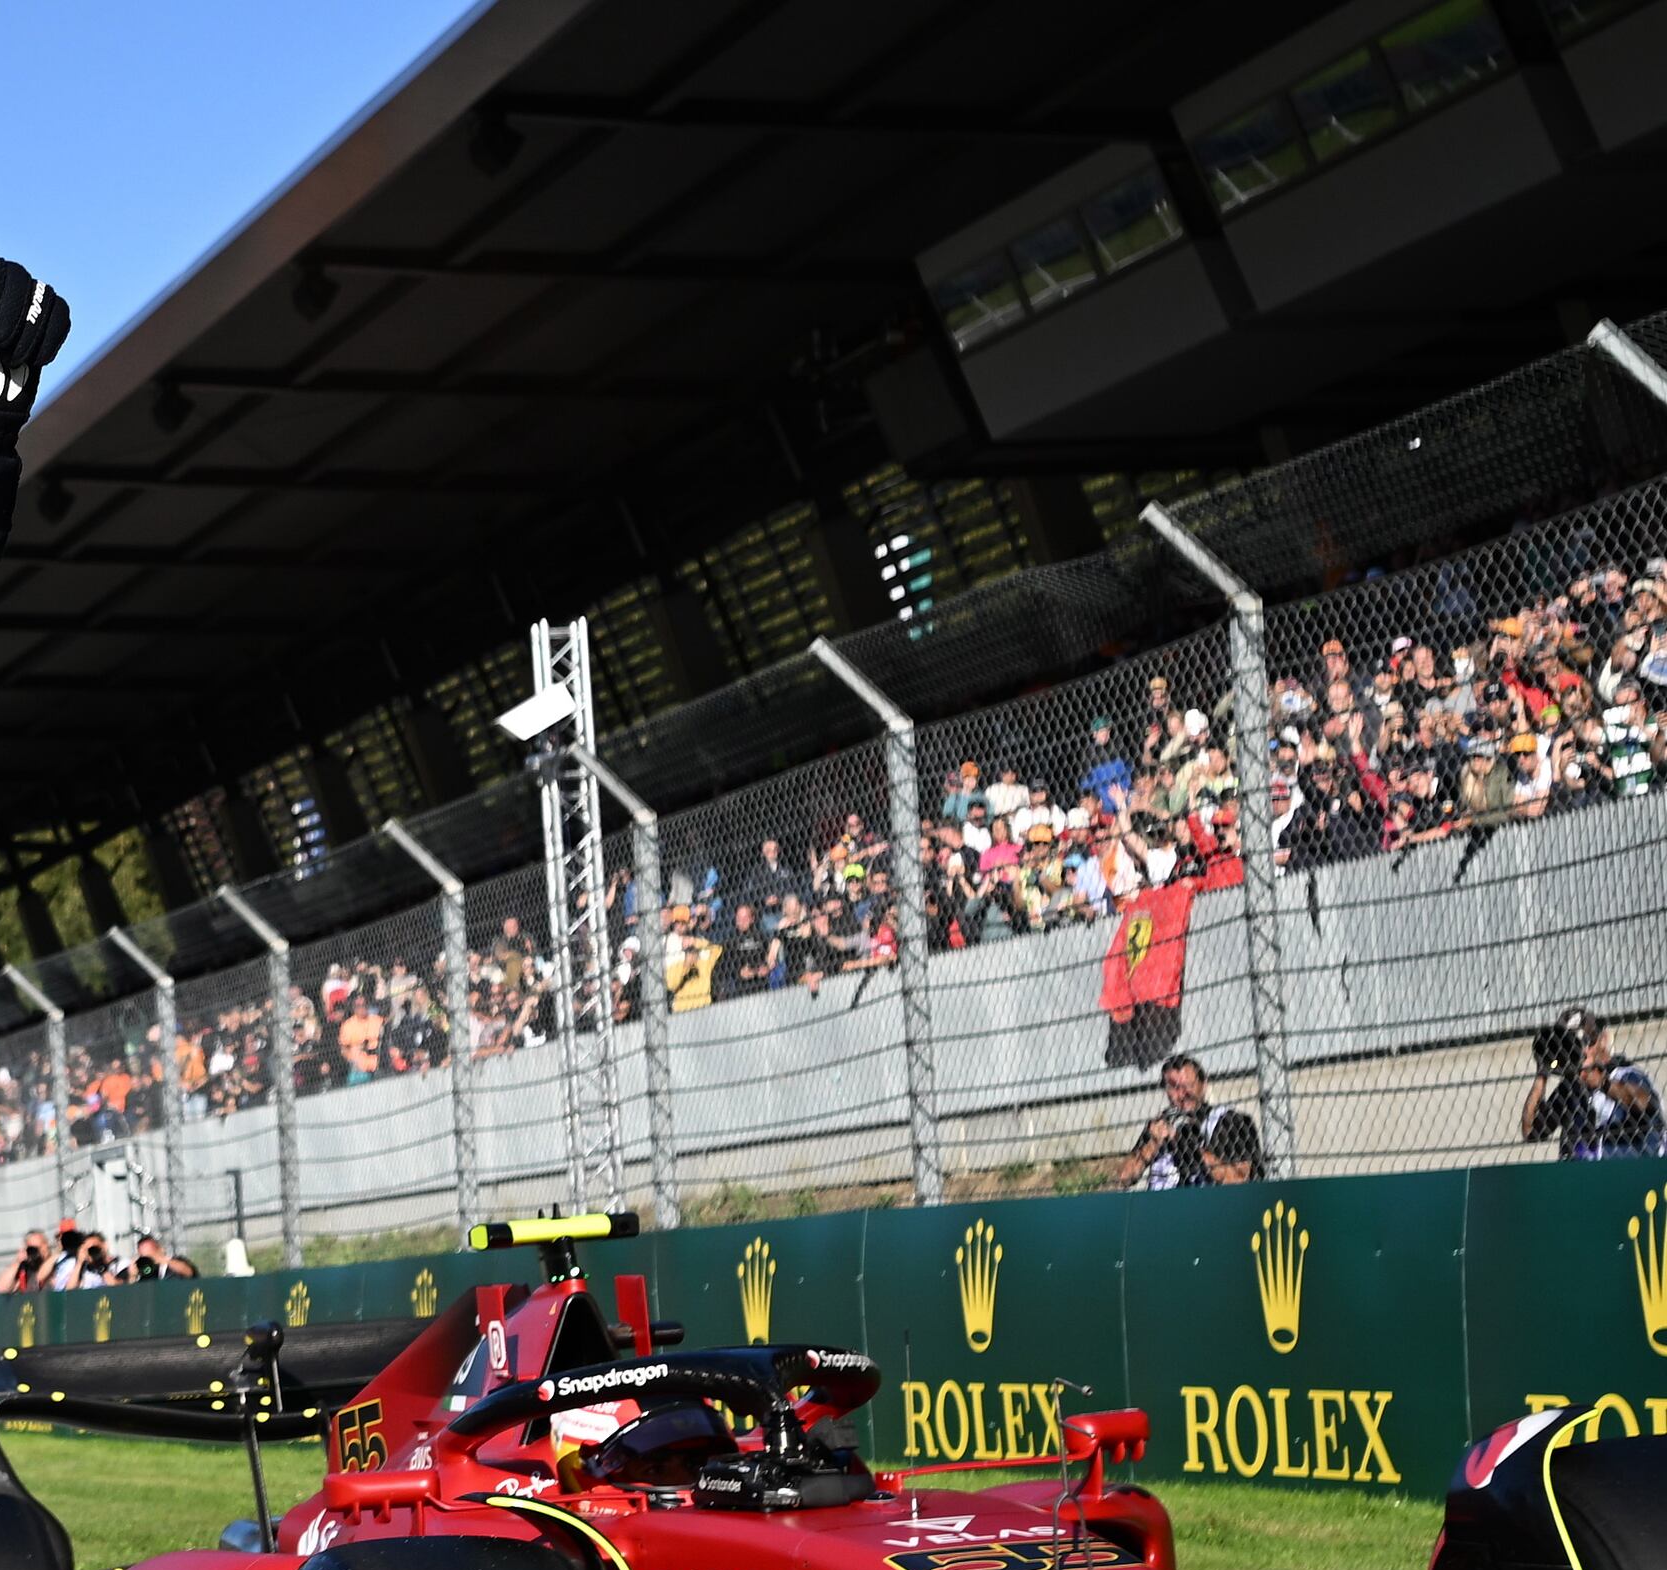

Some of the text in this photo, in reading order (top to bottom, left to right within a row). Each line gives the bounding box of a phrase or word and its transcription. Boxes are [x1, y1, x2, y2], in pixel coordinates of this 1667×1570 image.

[558, 1363, 668, 1396] Snapdragon
[338, 1399, 388, 1474] 55
[900, 1379, 1065, 1461] ROLEX
[1180, 1384, 1402, 1484] ROLEX
[883, 1525, 1066, 1548] VELAS
